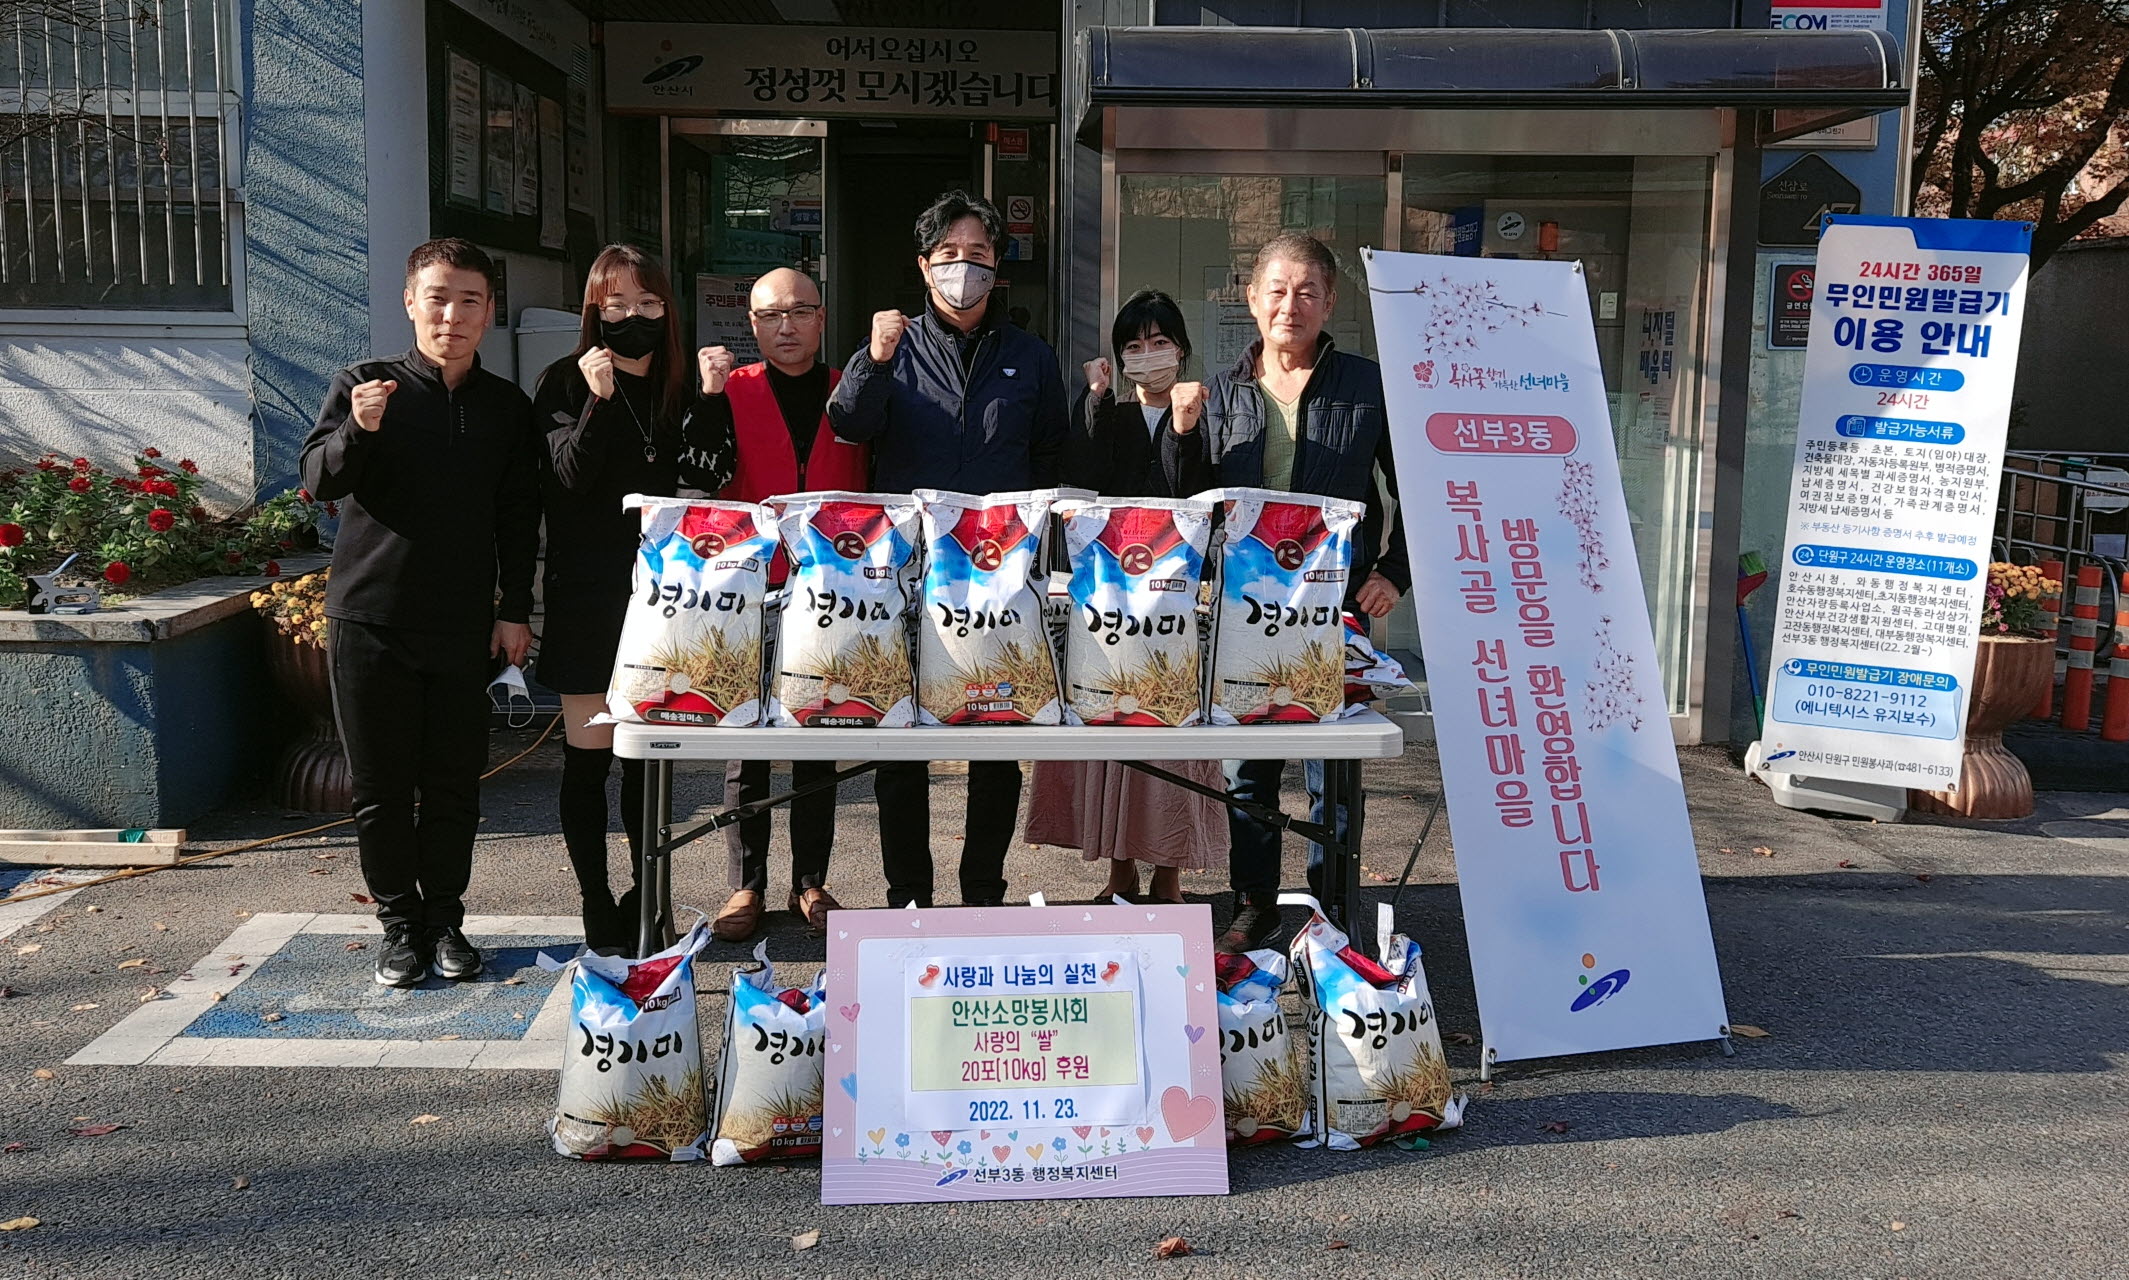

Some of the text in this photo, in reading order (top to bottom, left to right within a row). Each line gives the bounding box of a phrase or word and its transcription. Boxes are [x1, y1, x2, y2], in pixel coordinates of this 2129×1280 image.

[826, 36, 980, 64] 어서오십시오
[653, 84, 693, 96] 안산시
[744, 67, 1057, 108] 정성껏 모시겠습니다
[1859, 261, 1982, 284] 24시간 365일
[705, 294, 747, 308] 주민등록
[1826, 283, 2010, 316] 무인민원발급기
[1834, 317, 1992, 358] 이용 안내
[1449, 362, 1487, 391] 복사꽃
[1486, 367, 1506, 381] 향기
[1520, 372, 1570, 392] 선녀마을
[1878, 369, 1942, 386] 운영시간
[1877, 392, 1929, 410] 24시간
[1453, 418, 1553, 450] 선부3동
[1874, 421, 1954, 440] 발급가능서류
[1802, 465, 1834, 477] 지방세
[1838, 469, 1870, 480] 세목별
[1799, 502, 1894, 520] 지방세 납세증명서 등
[1811, 522, 1840, 534] 부동산
[1882, 527, 1913, 541] 증명서
[1914, 530, 1935, 542] 추후
[1937, 532, 1977, 546] 발급예정
[1818, 550, 1848, 564] 단원구
[1850, 553, 1884, 568] 24시간
[1885, 555, 1970, 576] 운영장소(11개소)
[647, 579, 745, 619] 경기미
[937, 602, 1020, 638] 경기미
[1085, 603, 1185, 645] 경기미
[1242, 595, 1339, 637] 경기미
[1781, 633, 1818, 646] 선부3동
[1445, 480, 1534, 829] 복사골 선녀마을
[1806, 663, 1949, 689] 무인민원발급기 장애문의
[1501, 518, 1601, 893] 방문을 환영합니다
[1808, 684, 1927, 708] 010-8221-9112
[660, 712, 704, 723] 매송정미소
[820, 717, 864, 726] 매송정미소
[1795, 700, 1935, 727] (에니텍시스 유지보수)
[1799, 751, 1823, 763] 안산시
[1825, 754, 1850, 766] 단원구
[943, 963, 1097, 988] 사랑과 나눔의 실천
[952, 998, 1089, 1027] 안산소망봉사회
[1342, 1000, 1433, 1050] 경기미
[579, 1022, 683, 1073] 경기미
[974, 1031, 1020, 1054] 사랑의
[1219, 1014, 1284, 1066] 기미
[1056, 1055, 1089, 1080] 후원
[969, 1098, 1079, 1121] 2022. 11. 23.
[973, 1165, 1118, 1183] 선부3동 행정복지센터
